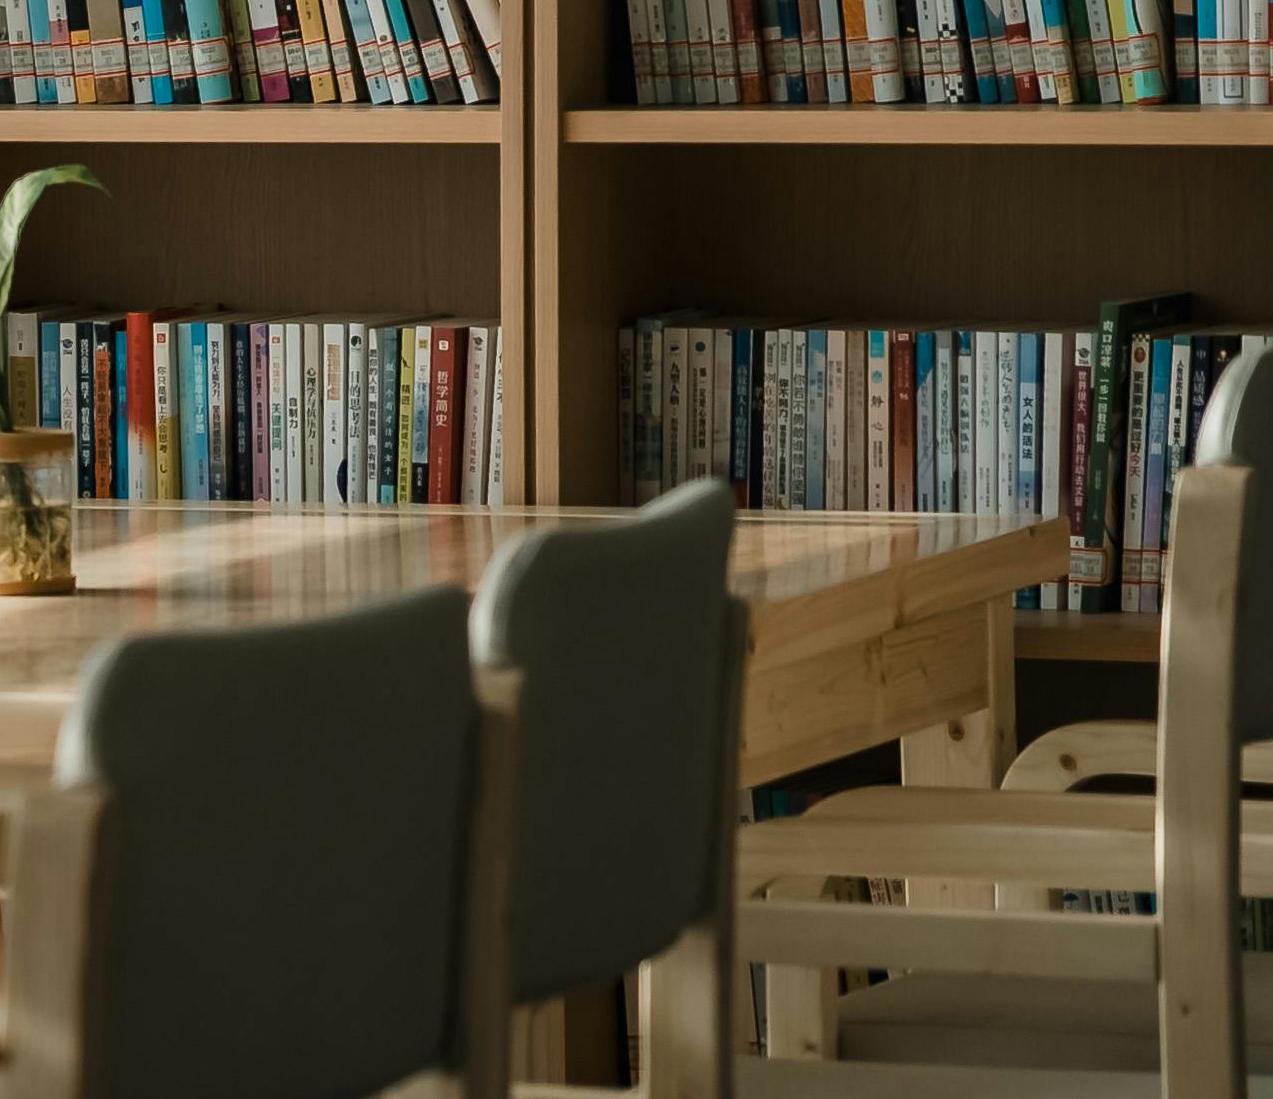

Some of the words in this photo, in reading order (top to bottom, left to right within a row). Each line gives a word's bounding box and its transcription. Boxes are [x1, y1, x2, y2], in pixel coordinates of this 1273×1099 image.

[435, 371, 447, 428] 哲学简史
[1022, 397, 1034, 460] 女人的活法
